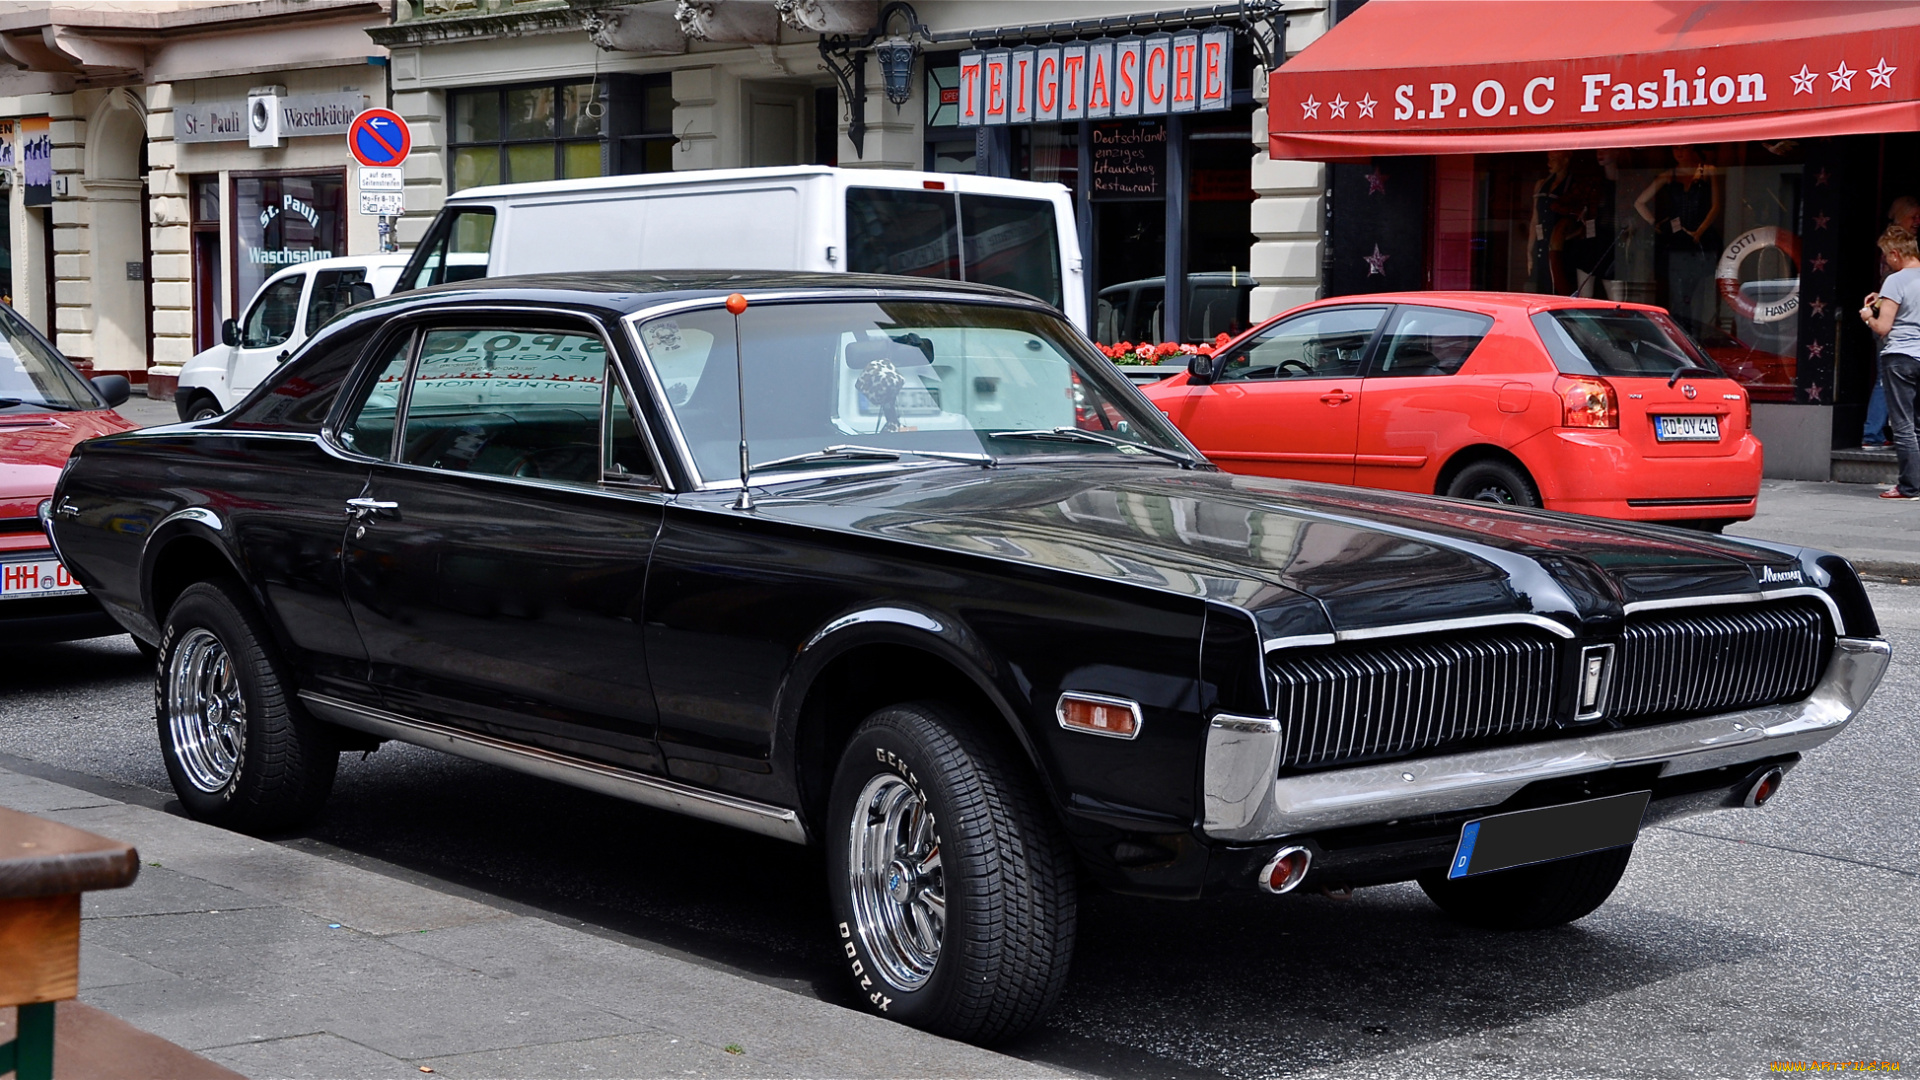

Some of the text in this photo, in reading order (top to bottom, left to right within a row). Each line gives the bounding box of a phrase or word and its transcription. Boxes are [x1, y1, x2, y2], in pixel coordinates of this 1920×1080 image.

[962, 42, 1222, 117] TEIGTASCHE
[1394, 67, 1768, 120] S.P.O.C Fashion
[210, 112, 240, 133] Pauli
[284, 104, 355, 128] Waschküche
[1093, 125, 1167, 144] Deutschlands
[1095, 148, 1145, 164] einziges
[1095, 177, 1158, 193] Restaurant
[260, 194, 320, 229] St. Pauli
[249, 246, 332, 264] Waschsalon
[1726, 233, 1757, 261] LOTTI
[1662, 419, 1677, 435] RD
[1699, 418, 1717, 434] 416
[5, 565, 38, 590] HH
[1458, 855, 1467, 868] D
[839, 921, 872, 991] 2000
